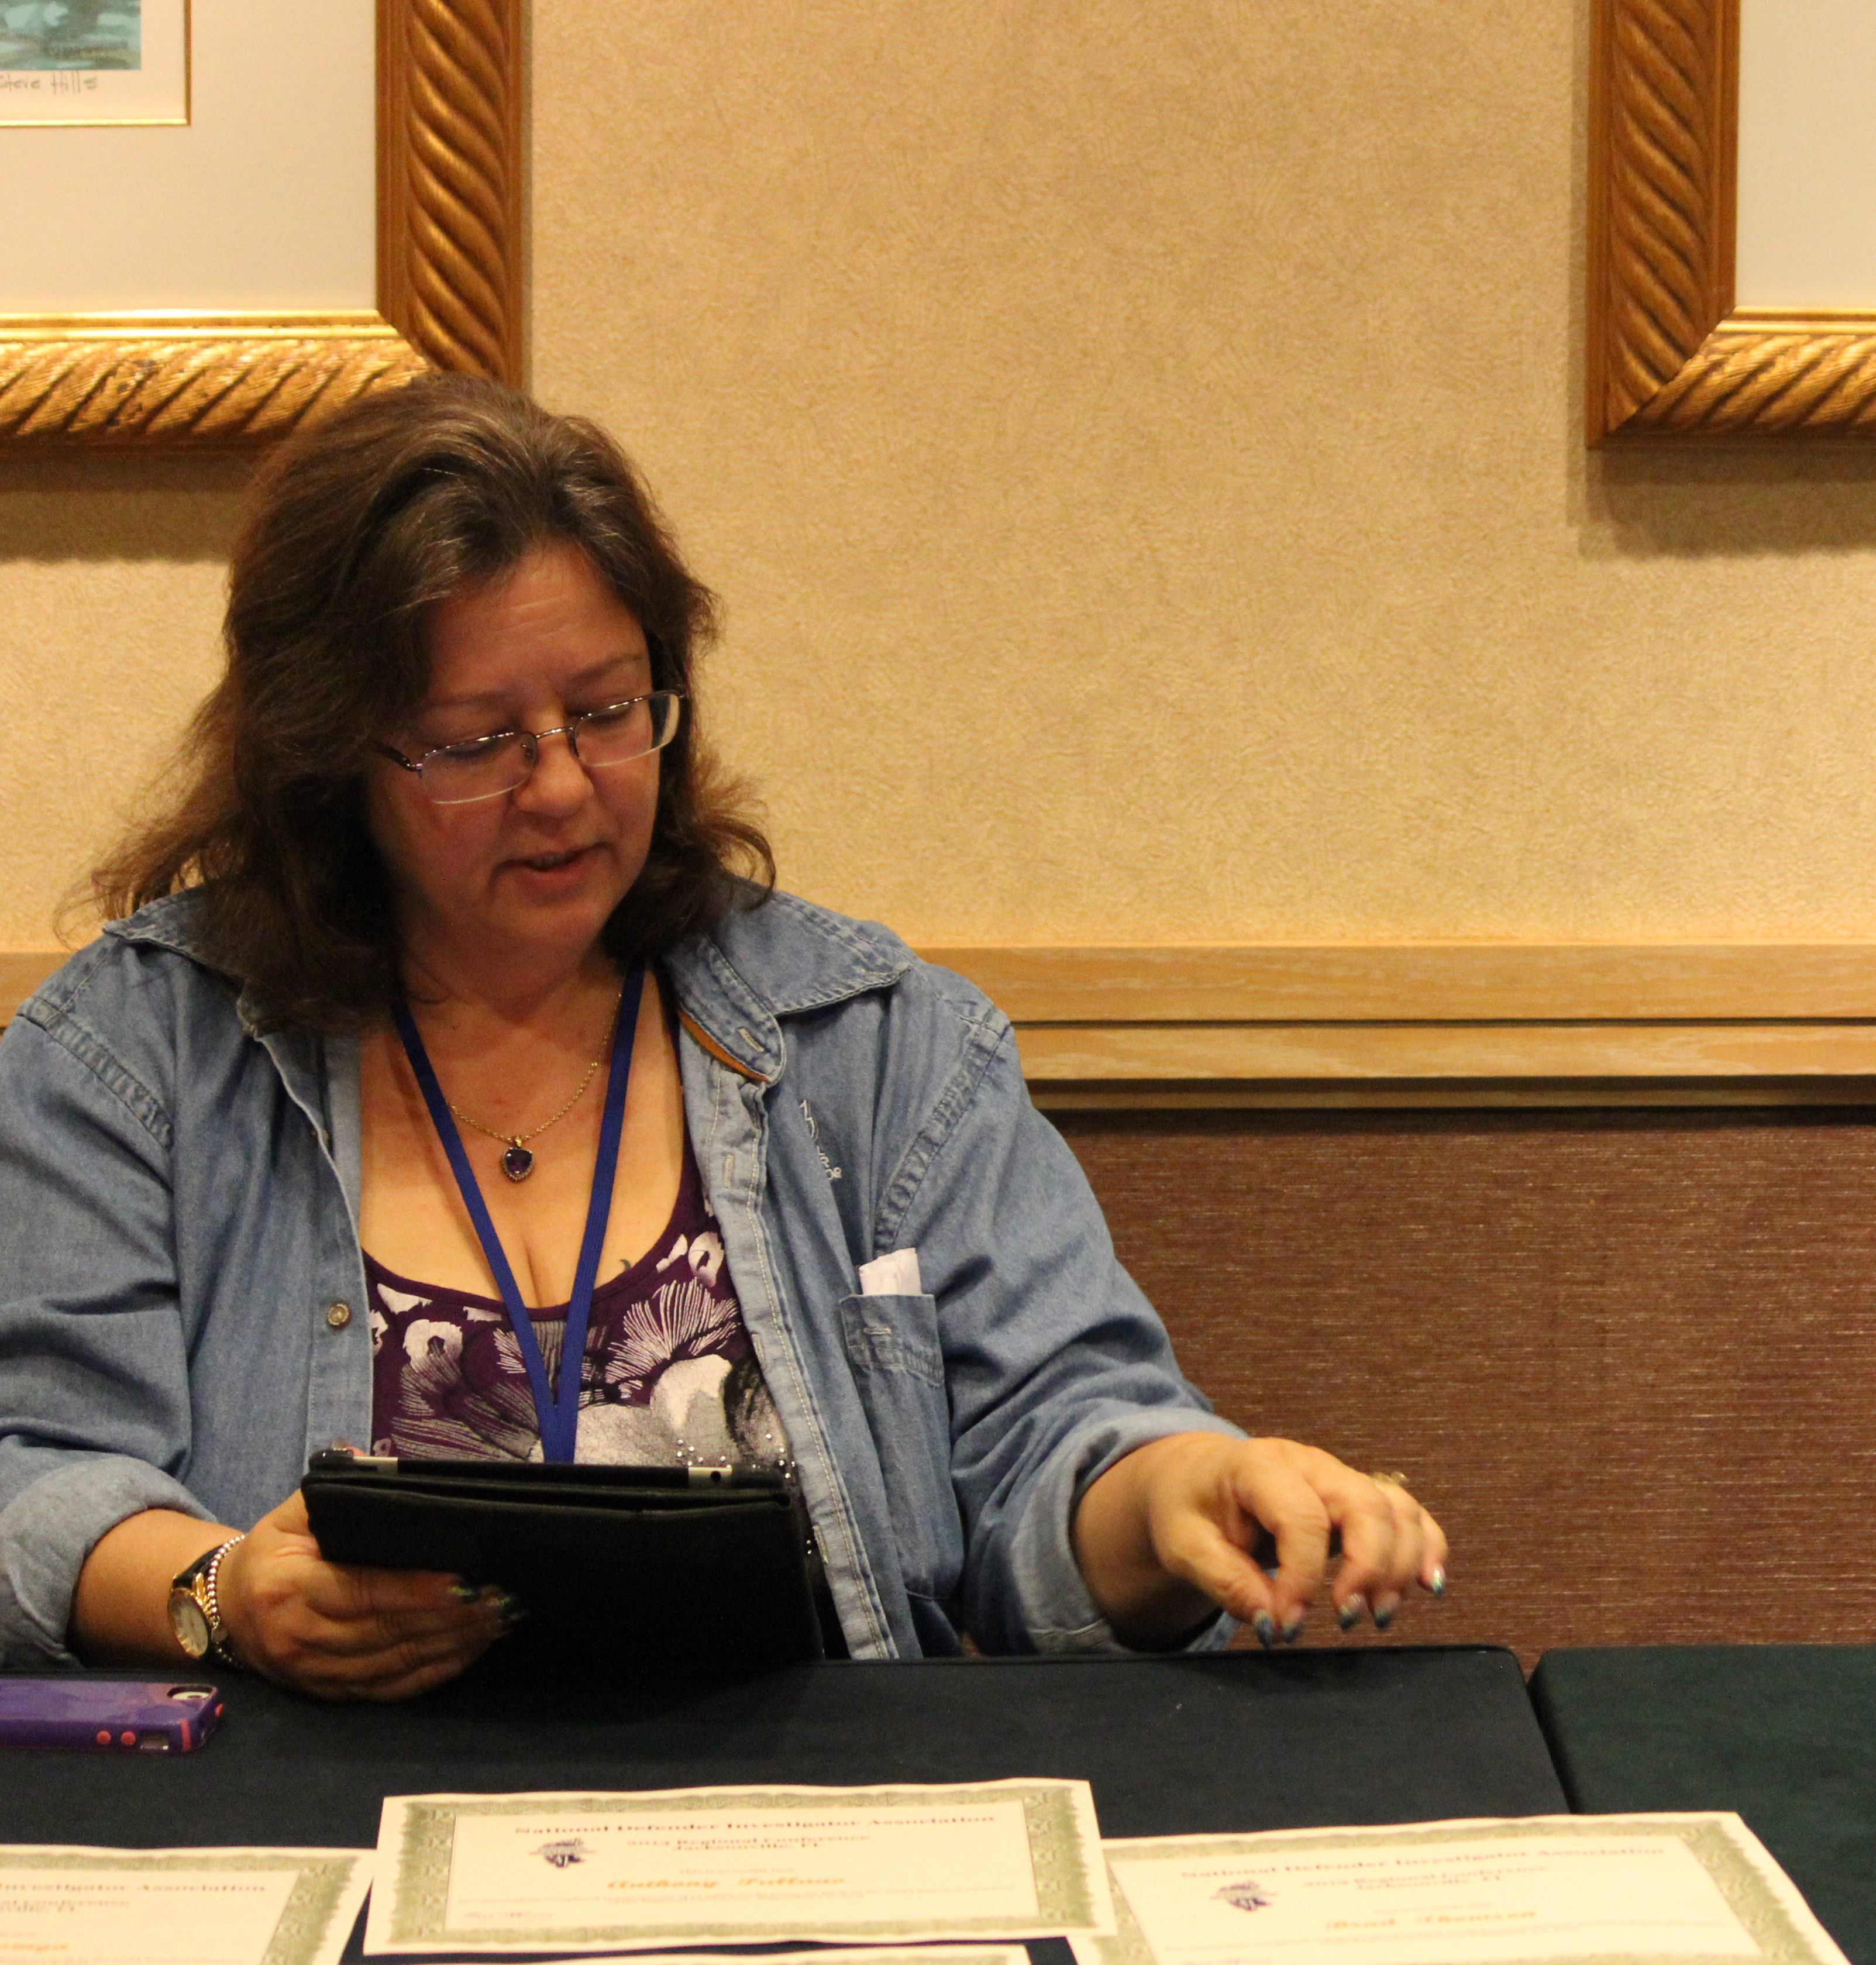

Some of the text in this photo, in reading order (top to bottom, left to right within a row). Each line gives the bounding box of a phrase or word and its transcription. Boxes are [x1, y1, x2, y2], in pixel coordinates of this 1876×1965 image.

[51, 70, 97, 94] Hills
[515, 1826, 608, 1834] National
[866, 1816, 994, 1825] Association
